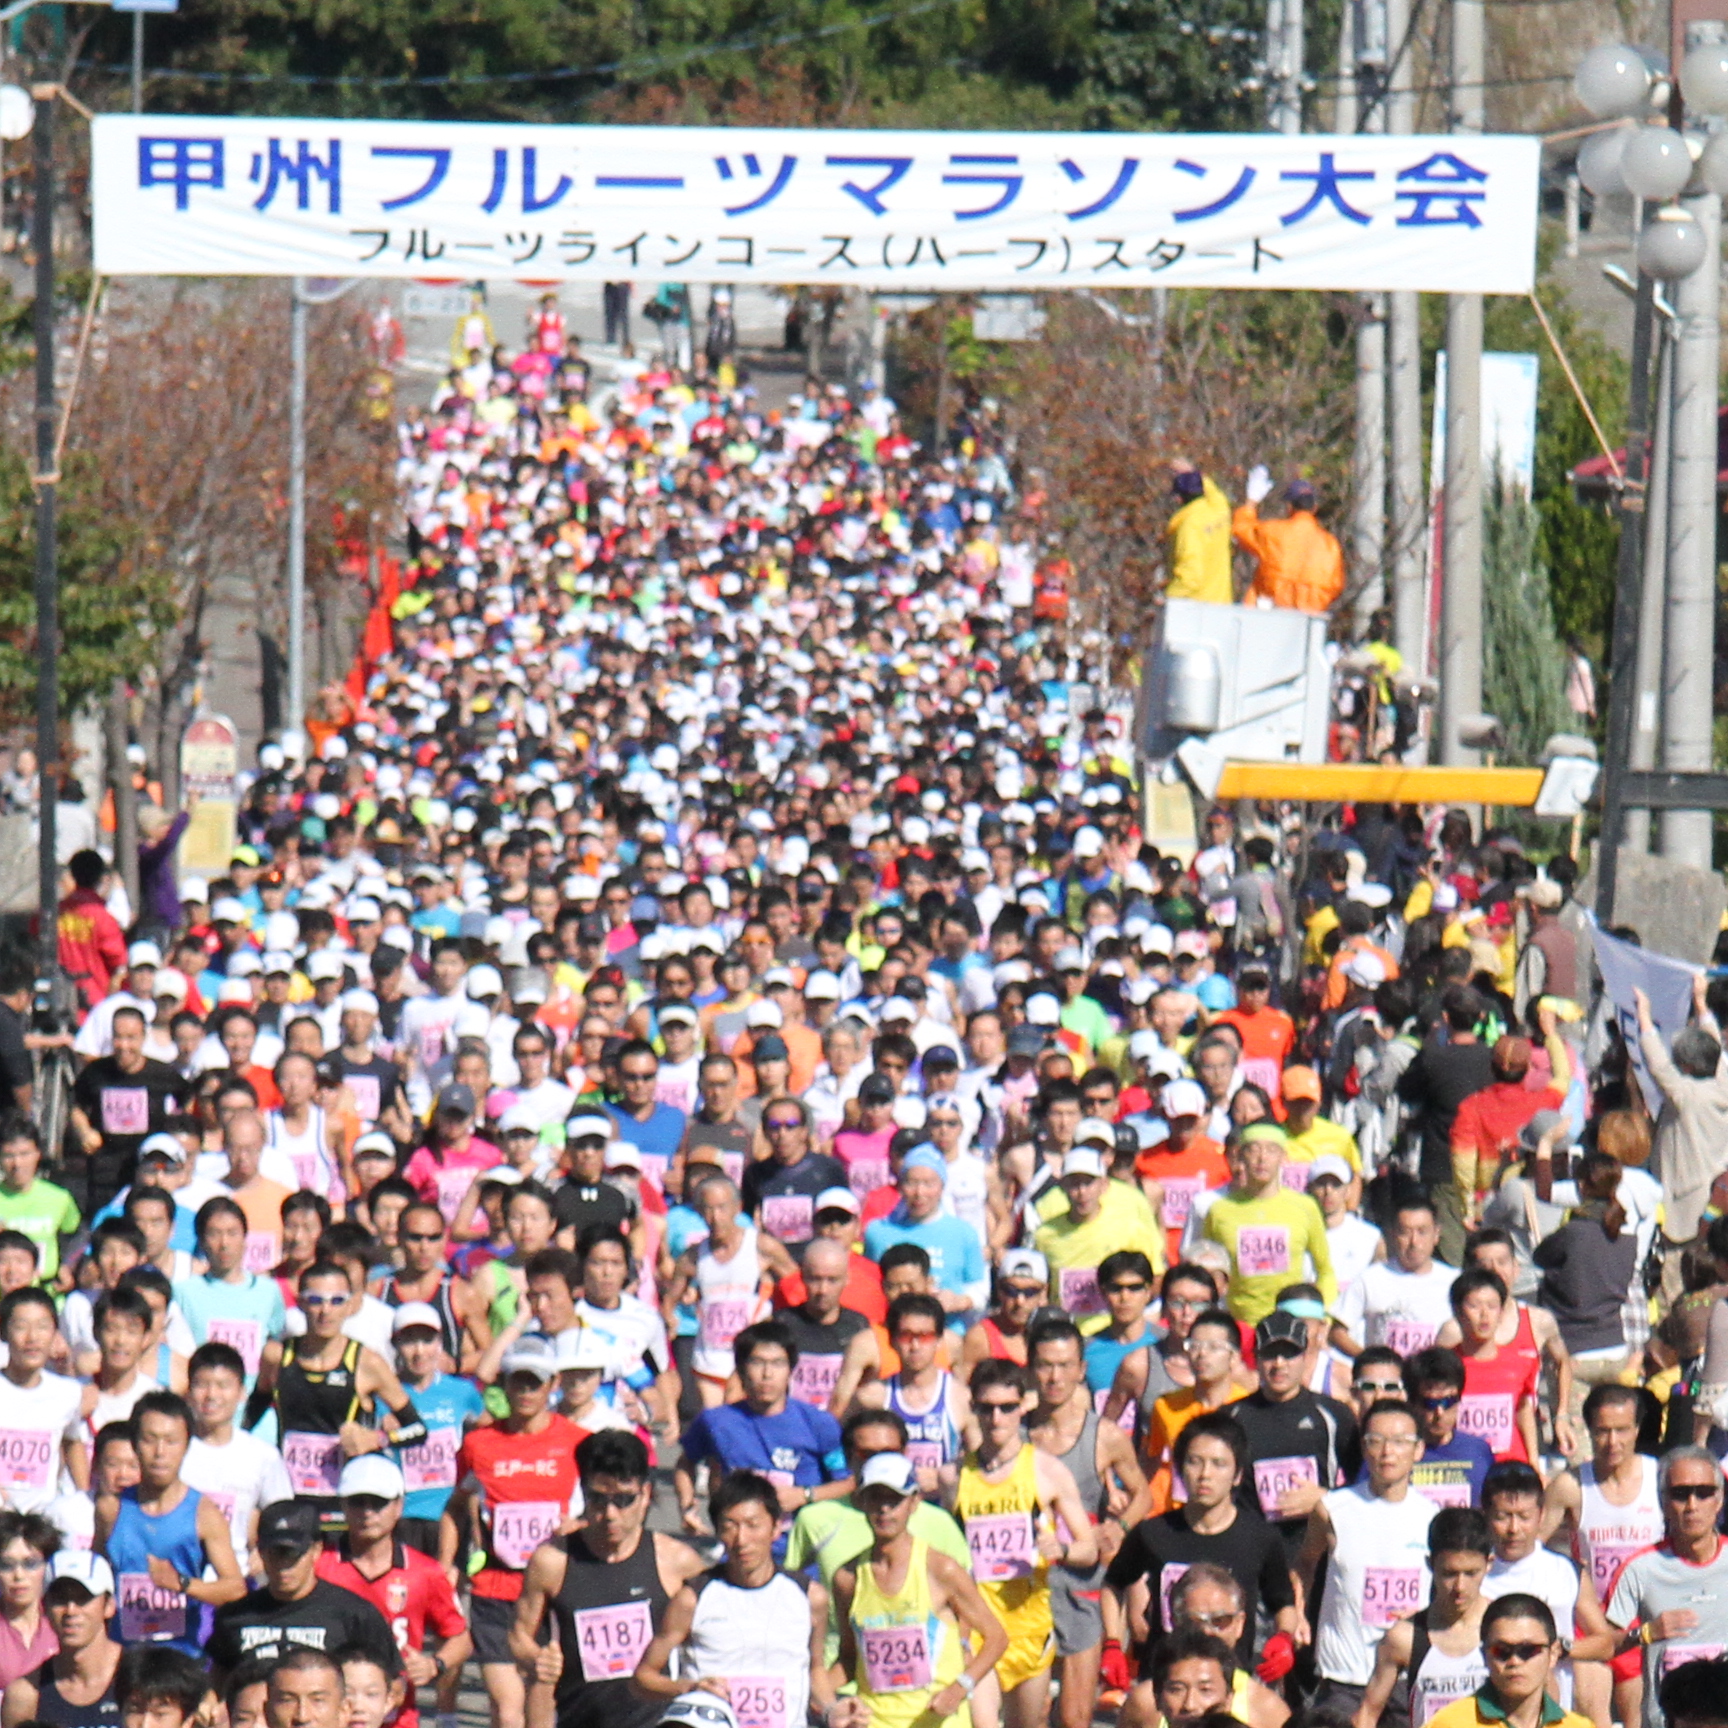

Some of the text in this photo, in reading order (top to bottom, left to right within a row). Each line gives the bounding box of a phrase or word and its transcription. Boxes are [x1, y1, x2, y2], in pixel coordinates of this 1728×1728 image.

[138, 135, 1489, 229] 甲州フルーツマラソン大会
[350, 228, 1284, 273] フルーツラインコース(ハーフ)スタート
[1458, 1408, 1510, 1430] 4065
[971, 1529, 1027, 1554] 4427
[1363, 1576, 1420, 1602] 5136
[583, 1619, 647, 1650] 4187
[865, 1639, 925, 1667] 5234
